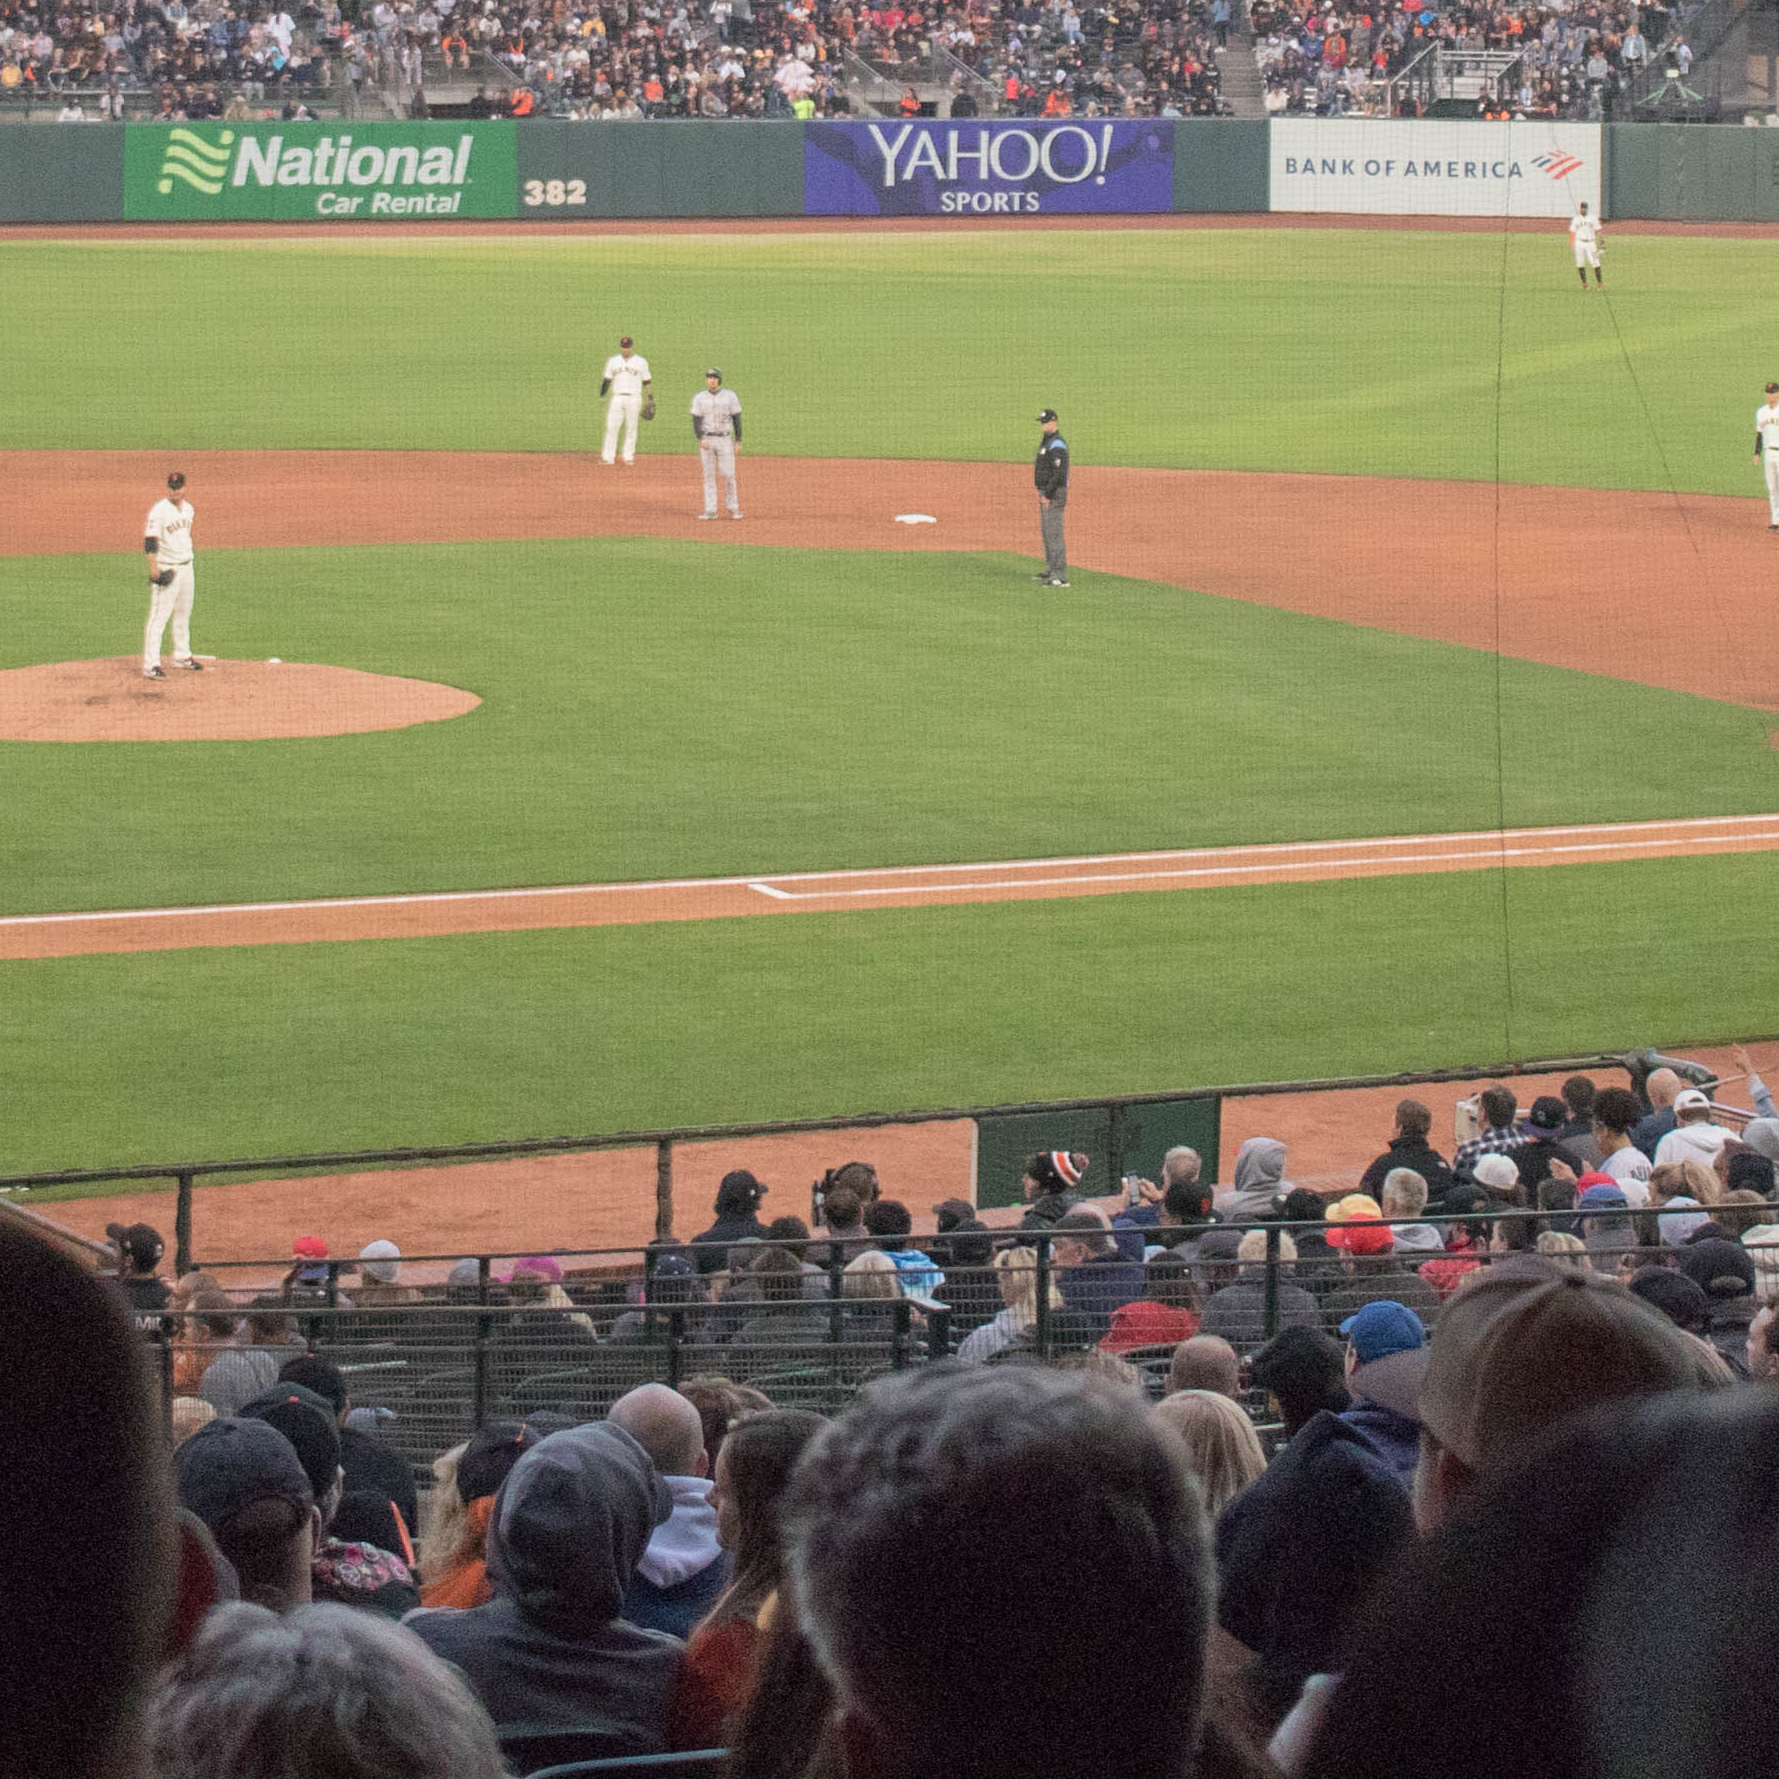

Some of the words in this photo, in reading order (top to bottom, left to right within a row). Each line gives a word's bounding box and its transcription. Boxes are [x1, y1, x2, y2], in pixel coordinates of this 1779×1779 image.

[231, 134, 474, 187] National
[867, 123, 1114, 188] YAHOO!
[1285, 158, 1357, 178] BANK
[1364, 159, 1400, 179] OF
[1404, 159, 1524, 180] AMERICA
[316, 192, 368, 215] Car
[371, 190, 461, 214] Rental
[523, 180, 587, 206] 382
[940, 191, 1041, 213] SPORTS
